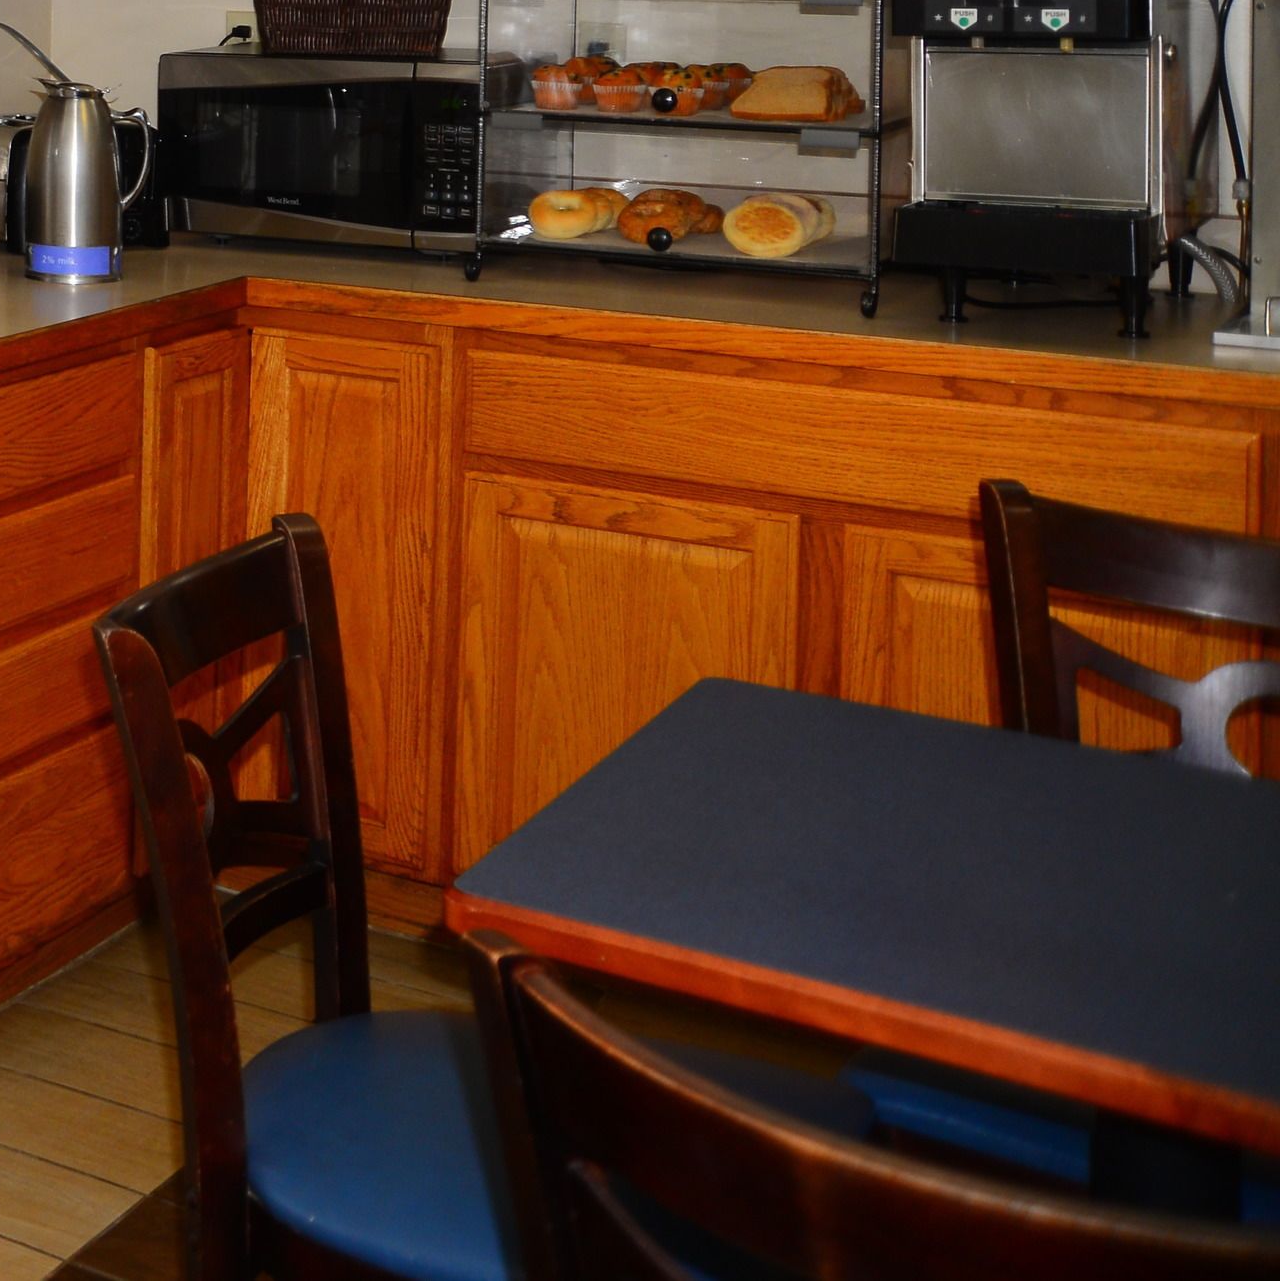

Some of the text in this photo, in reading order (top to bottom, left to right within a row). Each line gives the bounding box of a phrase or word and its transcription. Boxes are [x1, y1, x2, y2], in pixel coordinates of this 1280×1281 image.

[954, 9, 975, 17] PUSH
[1045, 10, 1066, 18] PUSH
[42, 254, 56, 265] 2%
